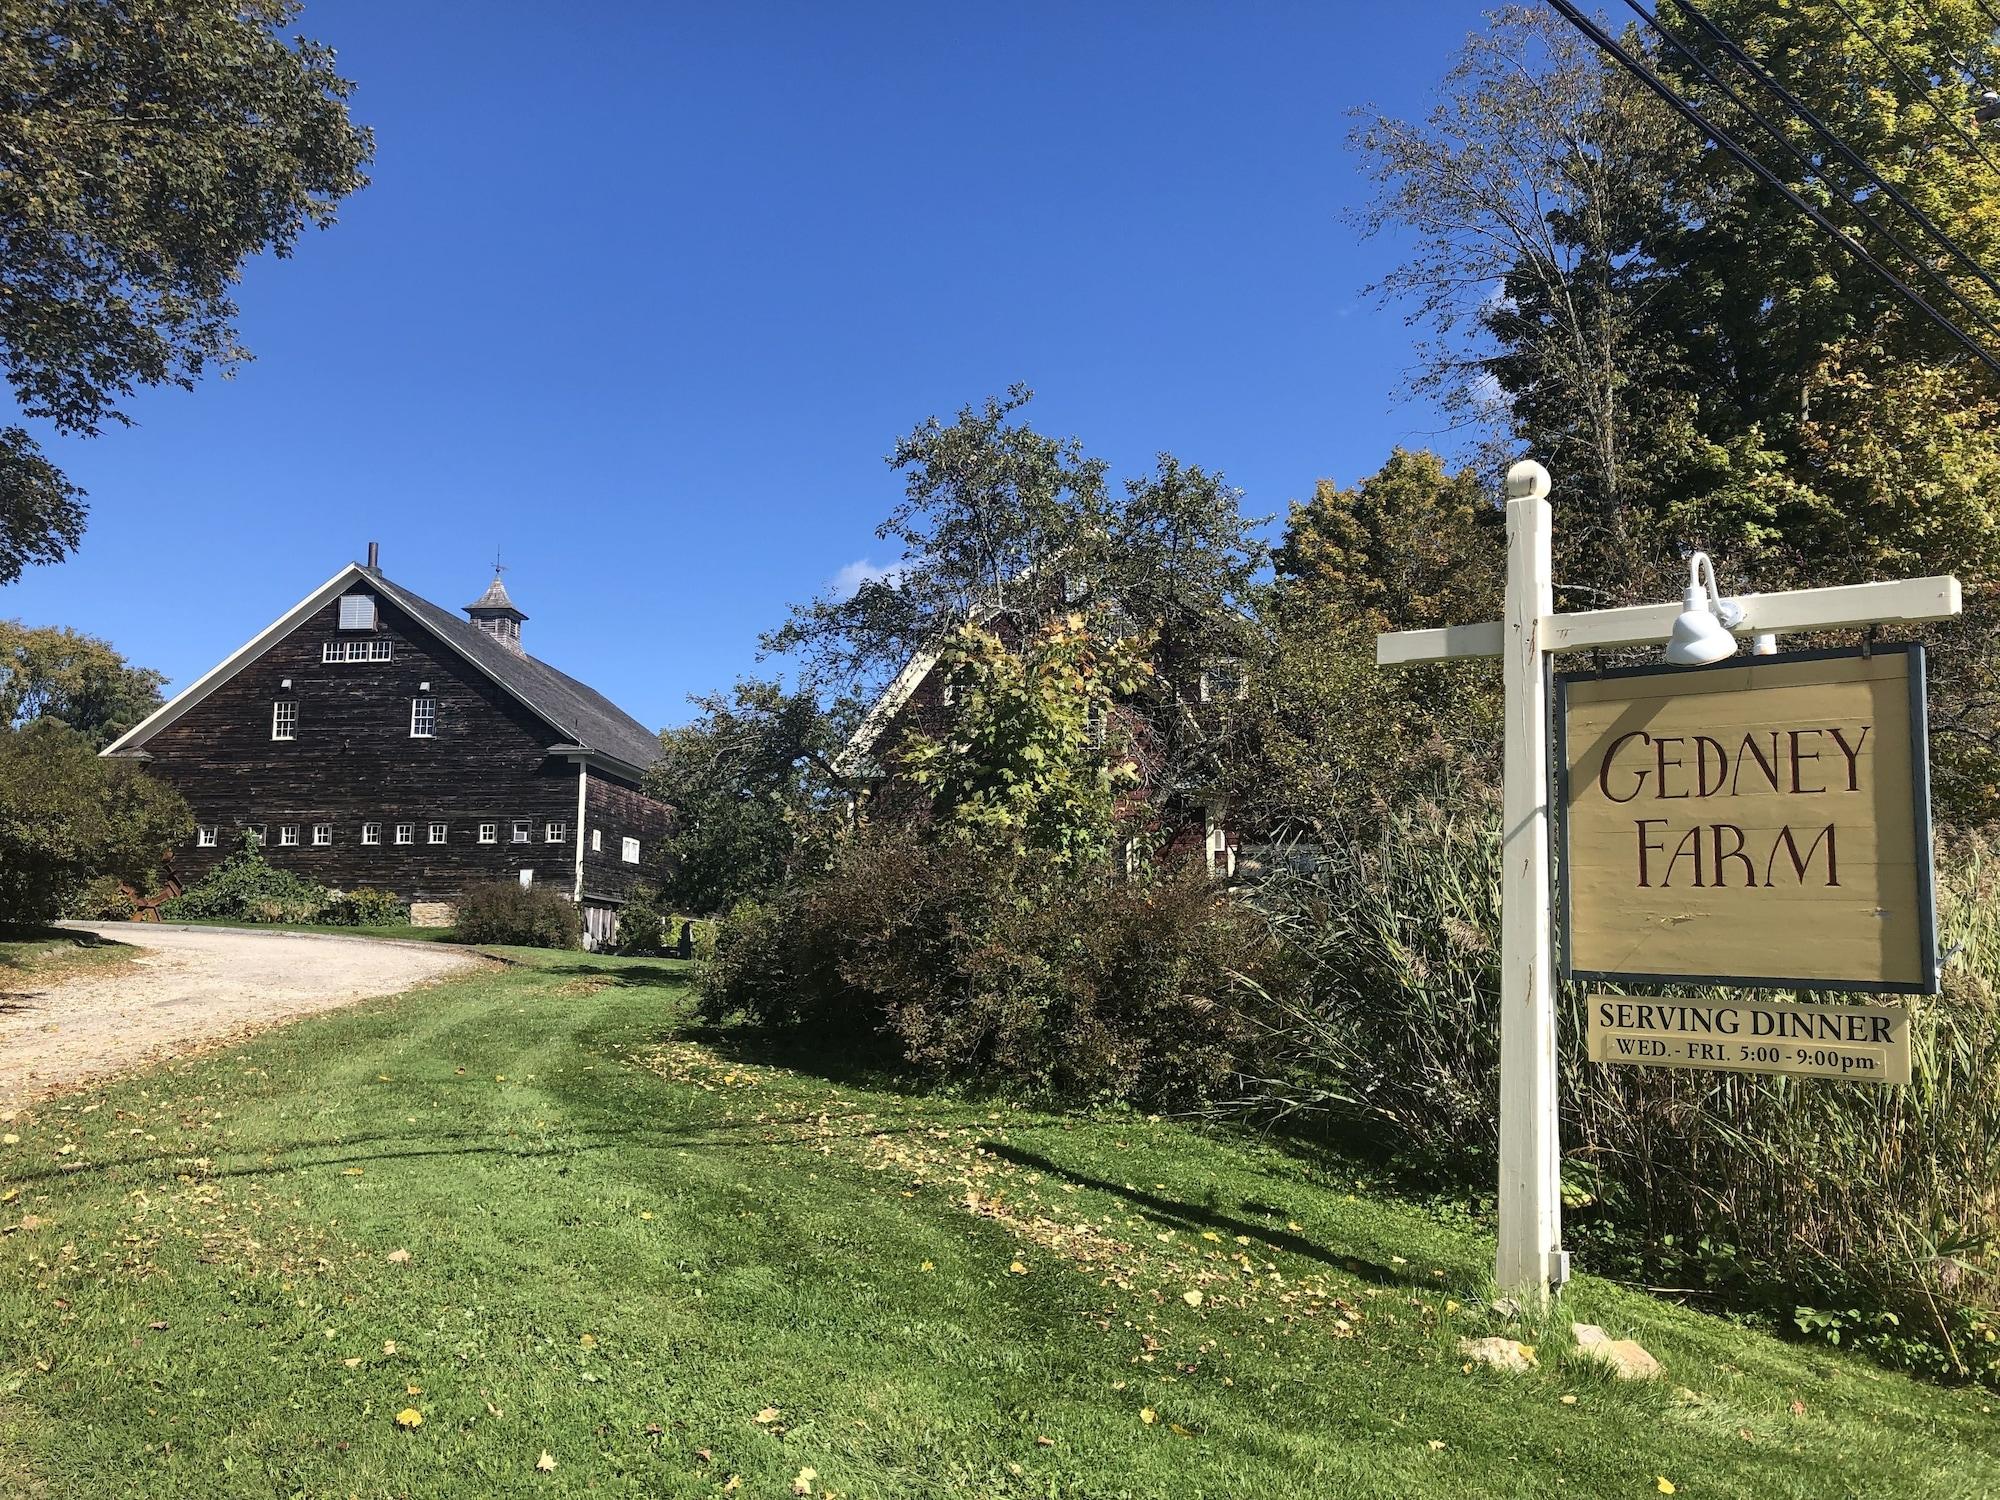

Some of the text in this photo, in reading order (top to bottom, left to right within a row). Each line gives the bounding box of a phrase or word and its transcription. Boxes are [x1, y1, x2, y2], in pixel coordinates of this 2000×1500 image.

[1599, 726, 1872, 803] GEDNEY
[1634, 818, 1842, 888] FARM
[1600, 1003, 1895, 1043] SERVING DINNER
[1687, 1043, 1731, 1061] FRI.
[1740, 1046, 1780, 1063] 5:00
[1797, 1049, 1875, 1073] 9:00pm
